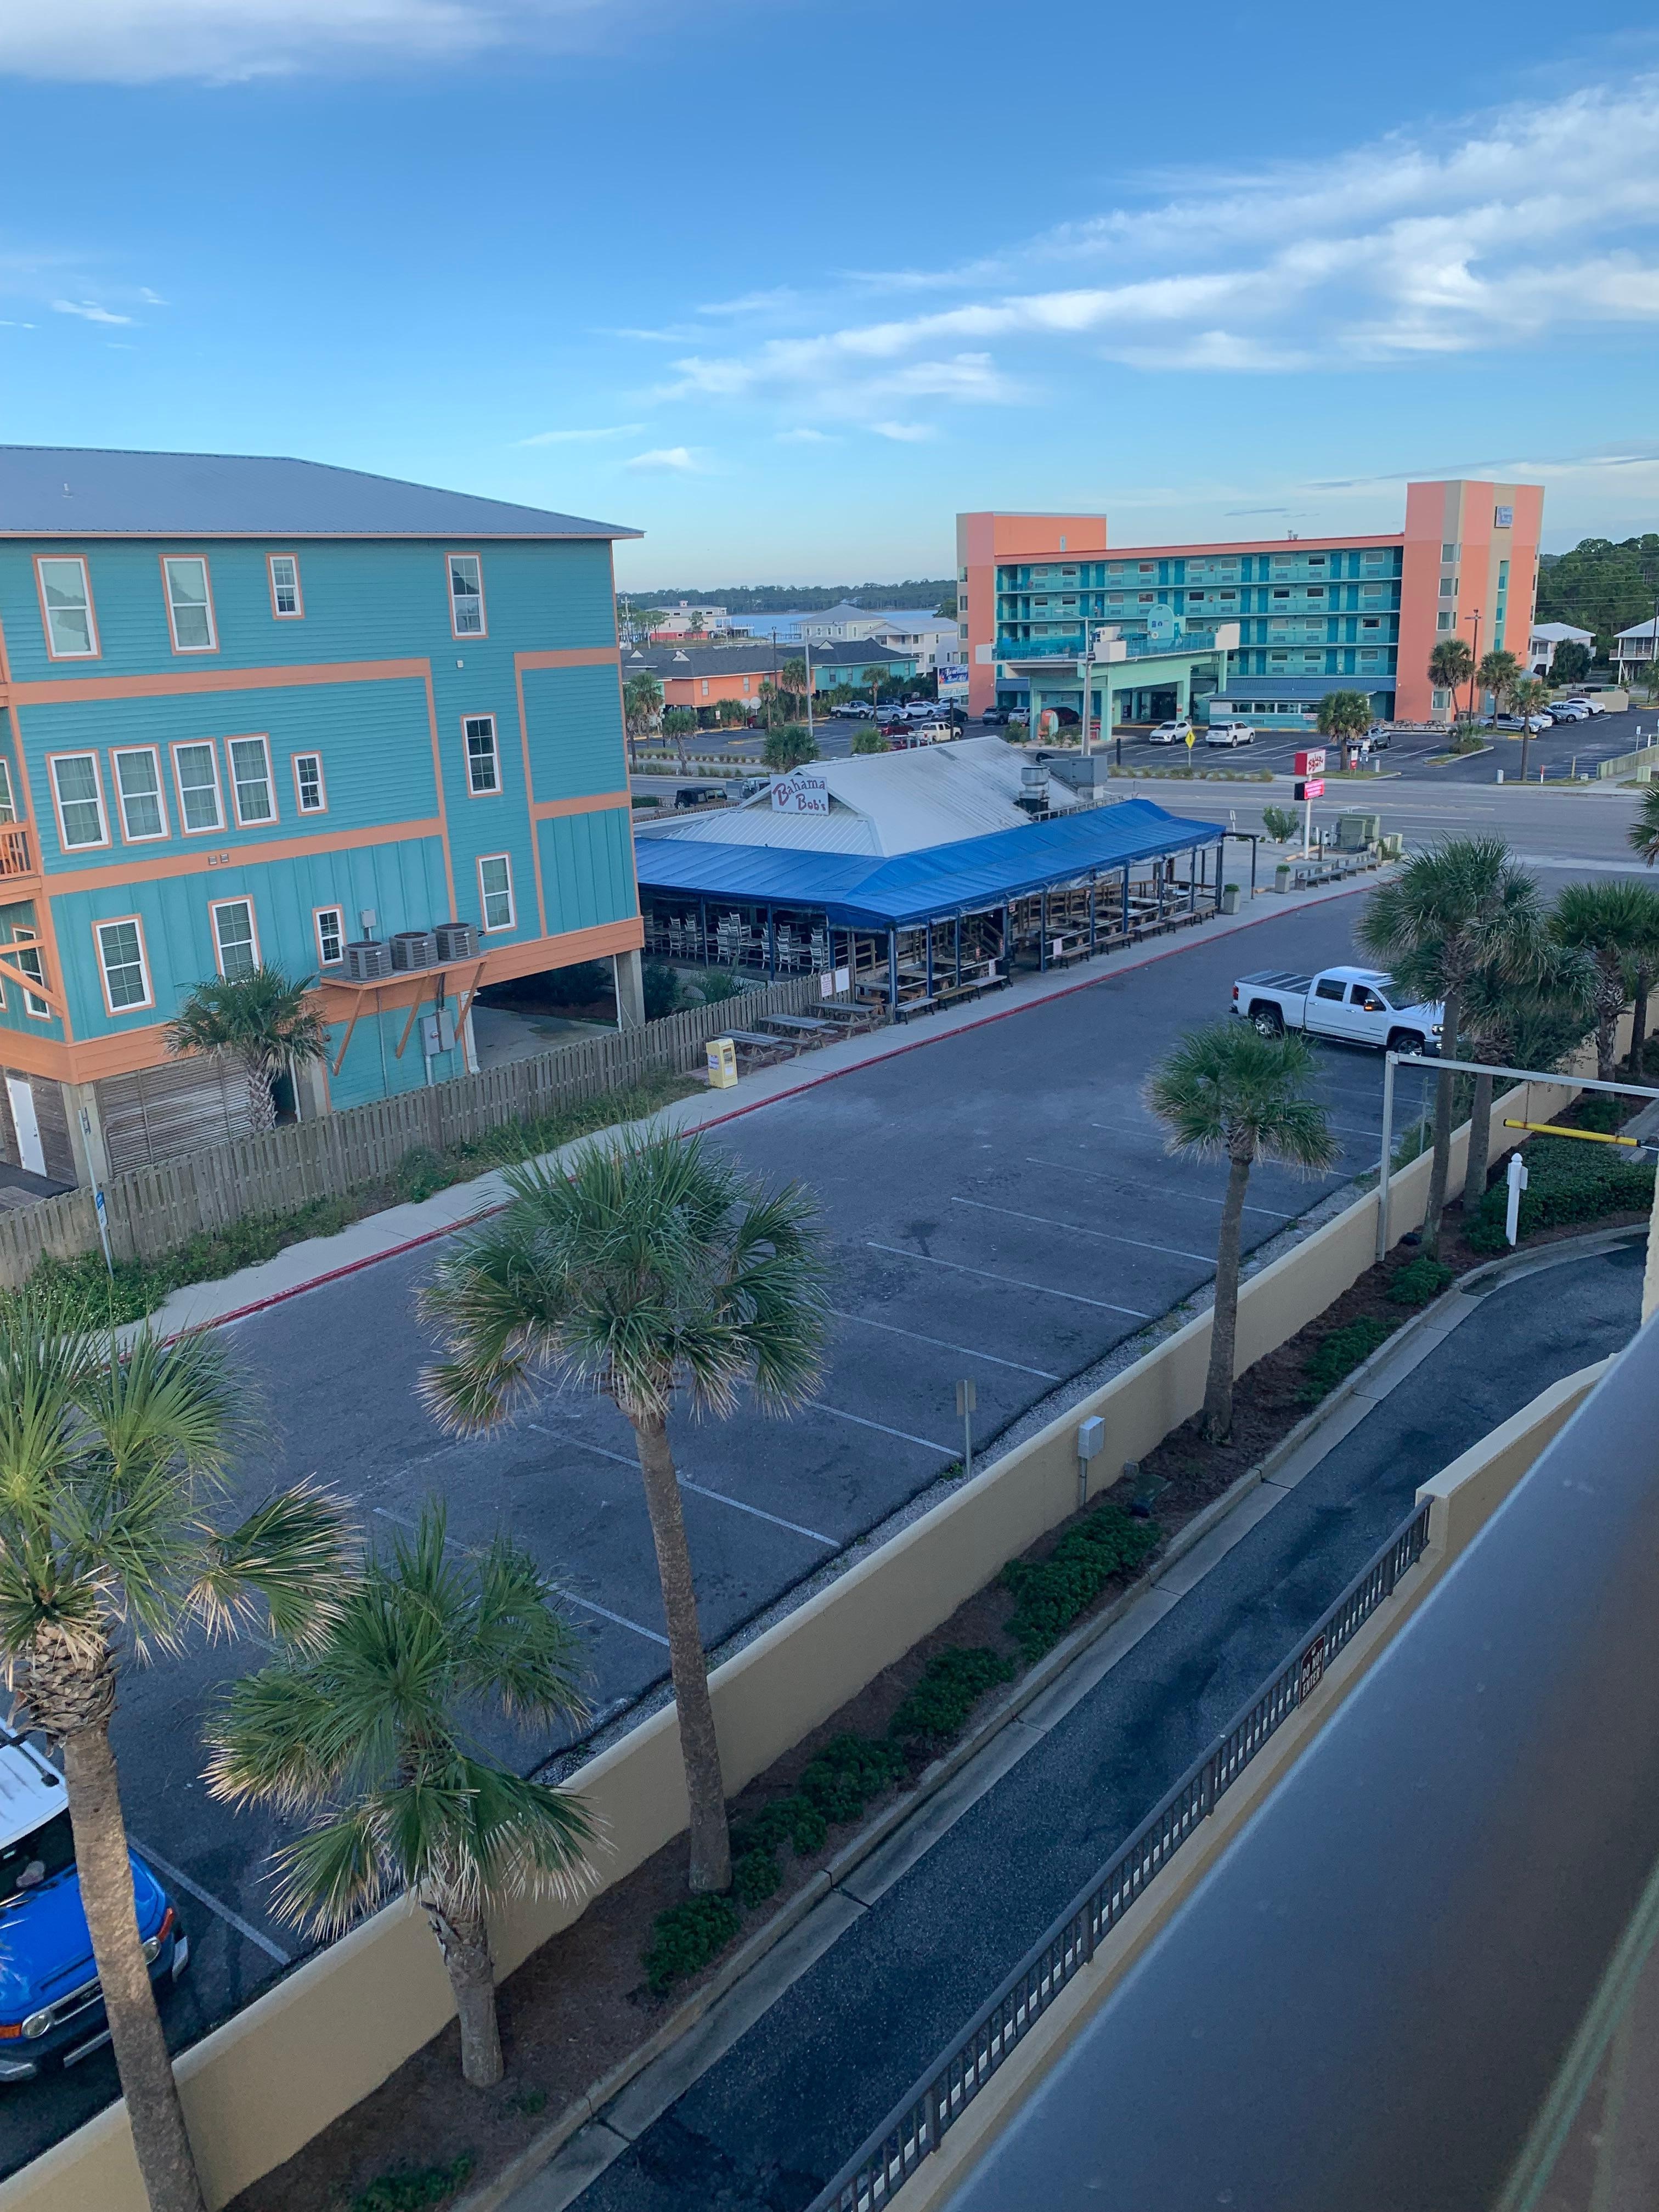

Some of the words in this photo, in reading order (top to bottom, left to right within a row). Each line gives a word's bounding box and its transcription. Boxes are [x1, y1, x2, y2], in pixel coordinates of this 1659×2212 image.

[772, 778, 826, 806] Bahama
[795, 793, 826, 811] Bob's
[1302, 1663, 1310, 1683] DO
[1312, 1647, 1323, 1672] NOT
[1302, 1666, 1321, 1697] ENTER
